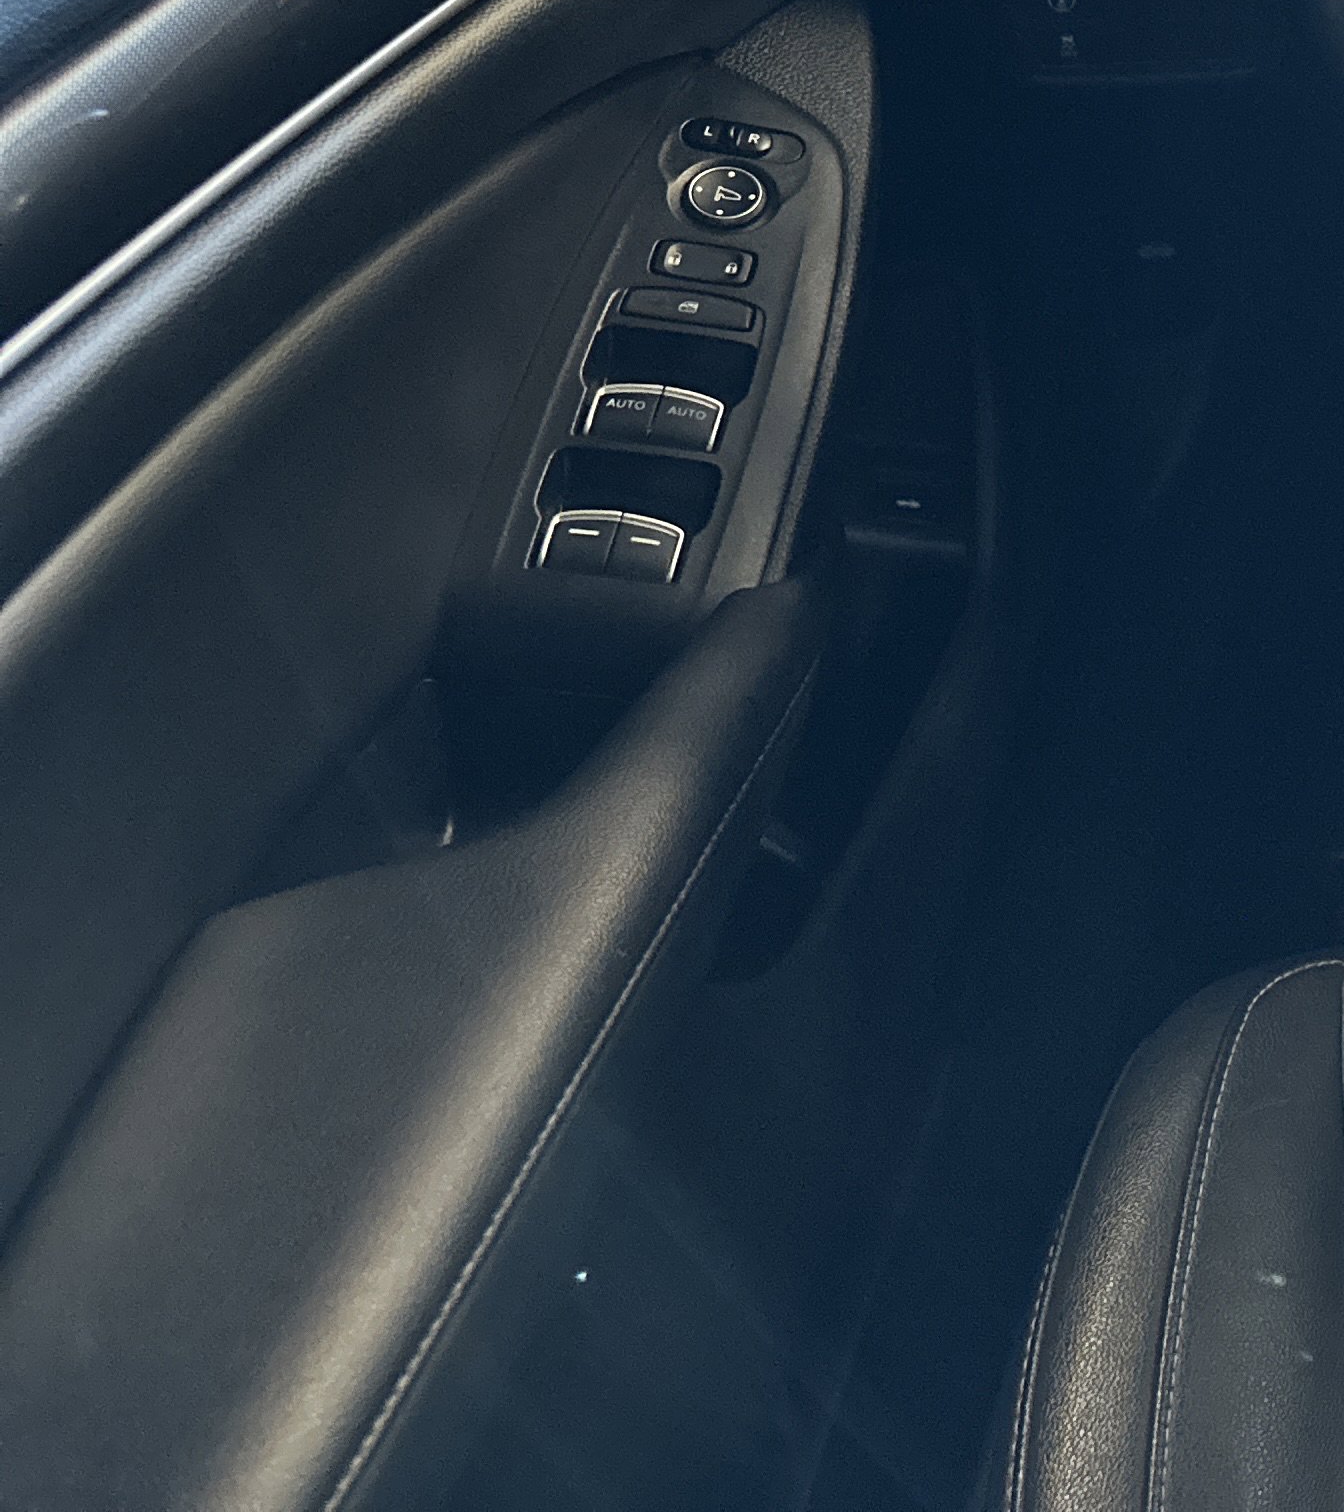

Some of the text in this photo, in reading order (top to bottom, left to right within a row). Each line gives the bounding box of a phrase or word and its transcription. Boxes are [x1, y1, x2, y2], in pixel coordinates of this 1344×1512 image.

[703, 125, 761, 144] L R
[605, 397, 647, 411] AUTO
[667, 405, 707, 421] AUTO
